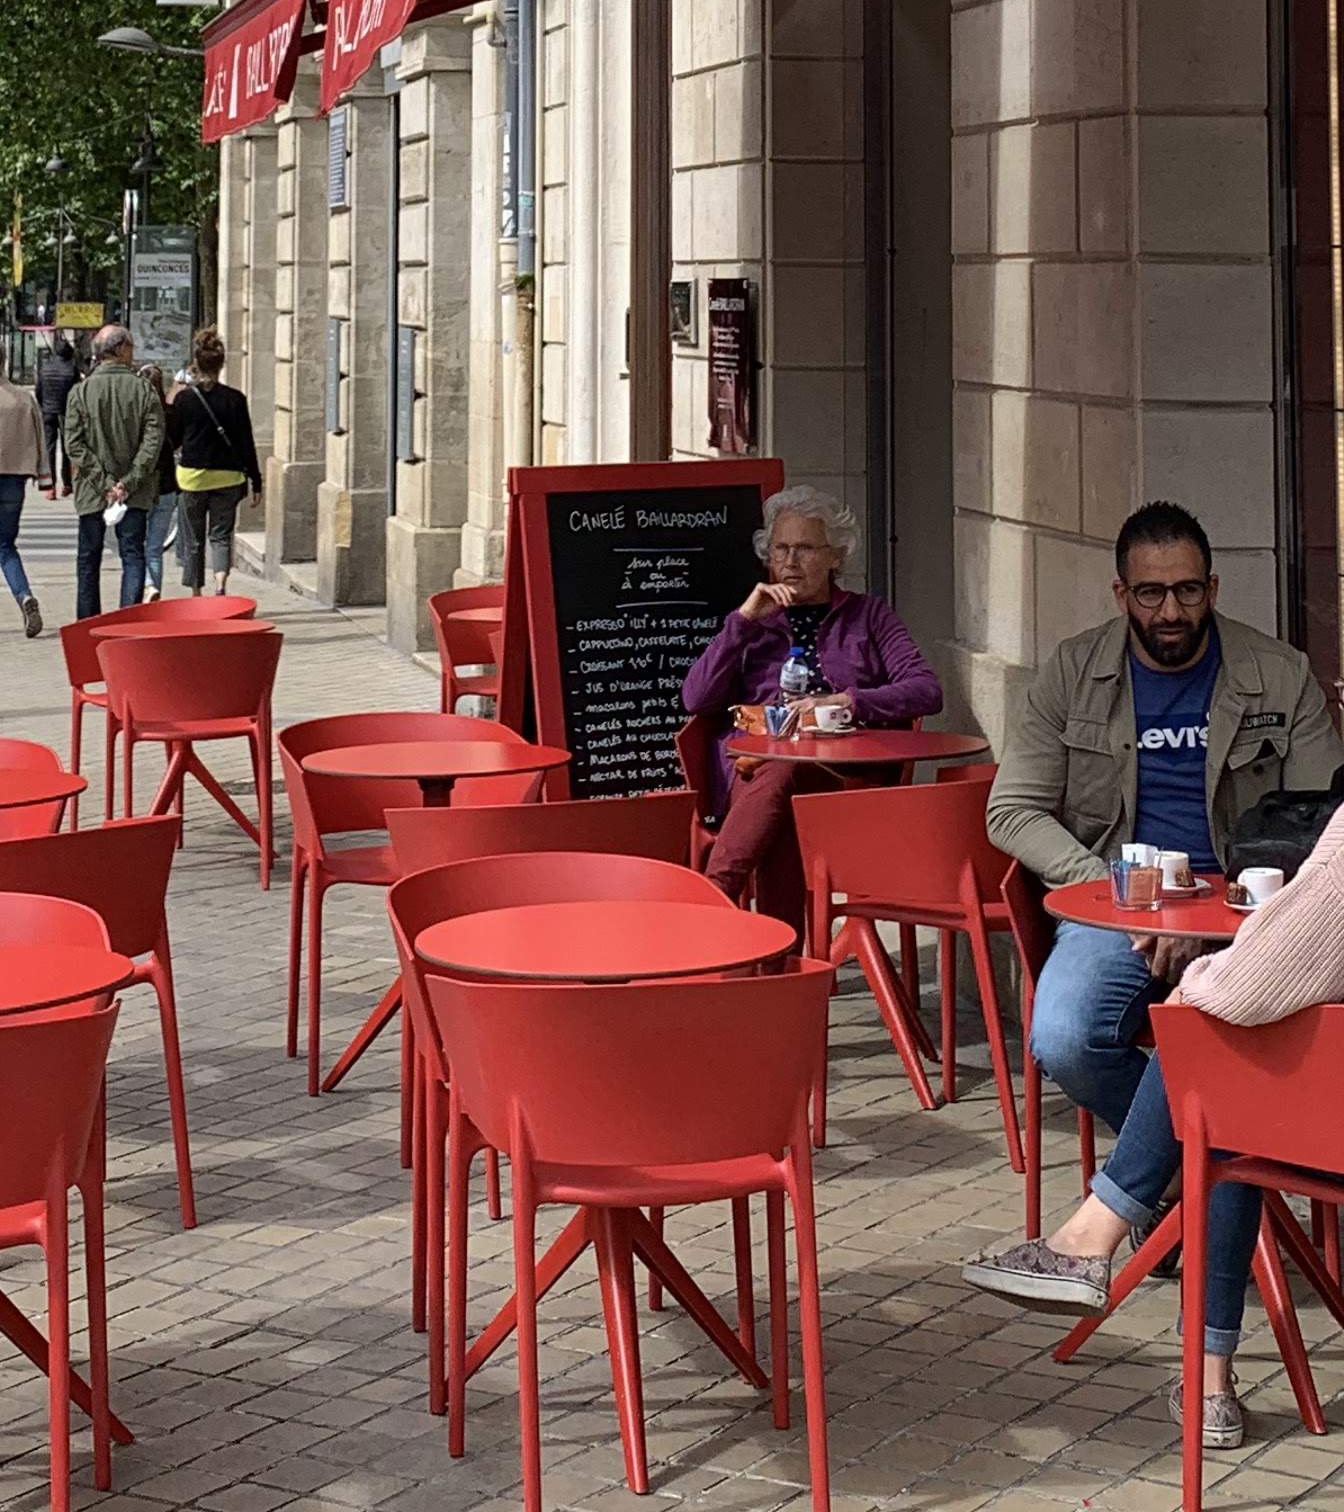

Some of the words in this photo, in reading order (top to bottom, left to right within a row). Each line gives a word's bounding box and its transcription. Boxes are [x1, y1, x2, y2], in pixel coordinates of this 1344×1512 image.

[569, 505, 625, 531] CANELÉ
[627, 557, 653, 569] sur
[656, 555, 689, 570] place
[621, 577, 632, 590] à
[640, 577, 689, 593] emporter
[576, 618, 625, 631] EXPRESSO
[585, 682, 604, 694] JUS
[585, 718, 622, 733] CANELÉS
[587, 734, 622, 750] CANELÉS
[590, 751, 637, 766] MACARONS
[639, 750, 653, 761] DE
[627, 770, 638, 779] DE
